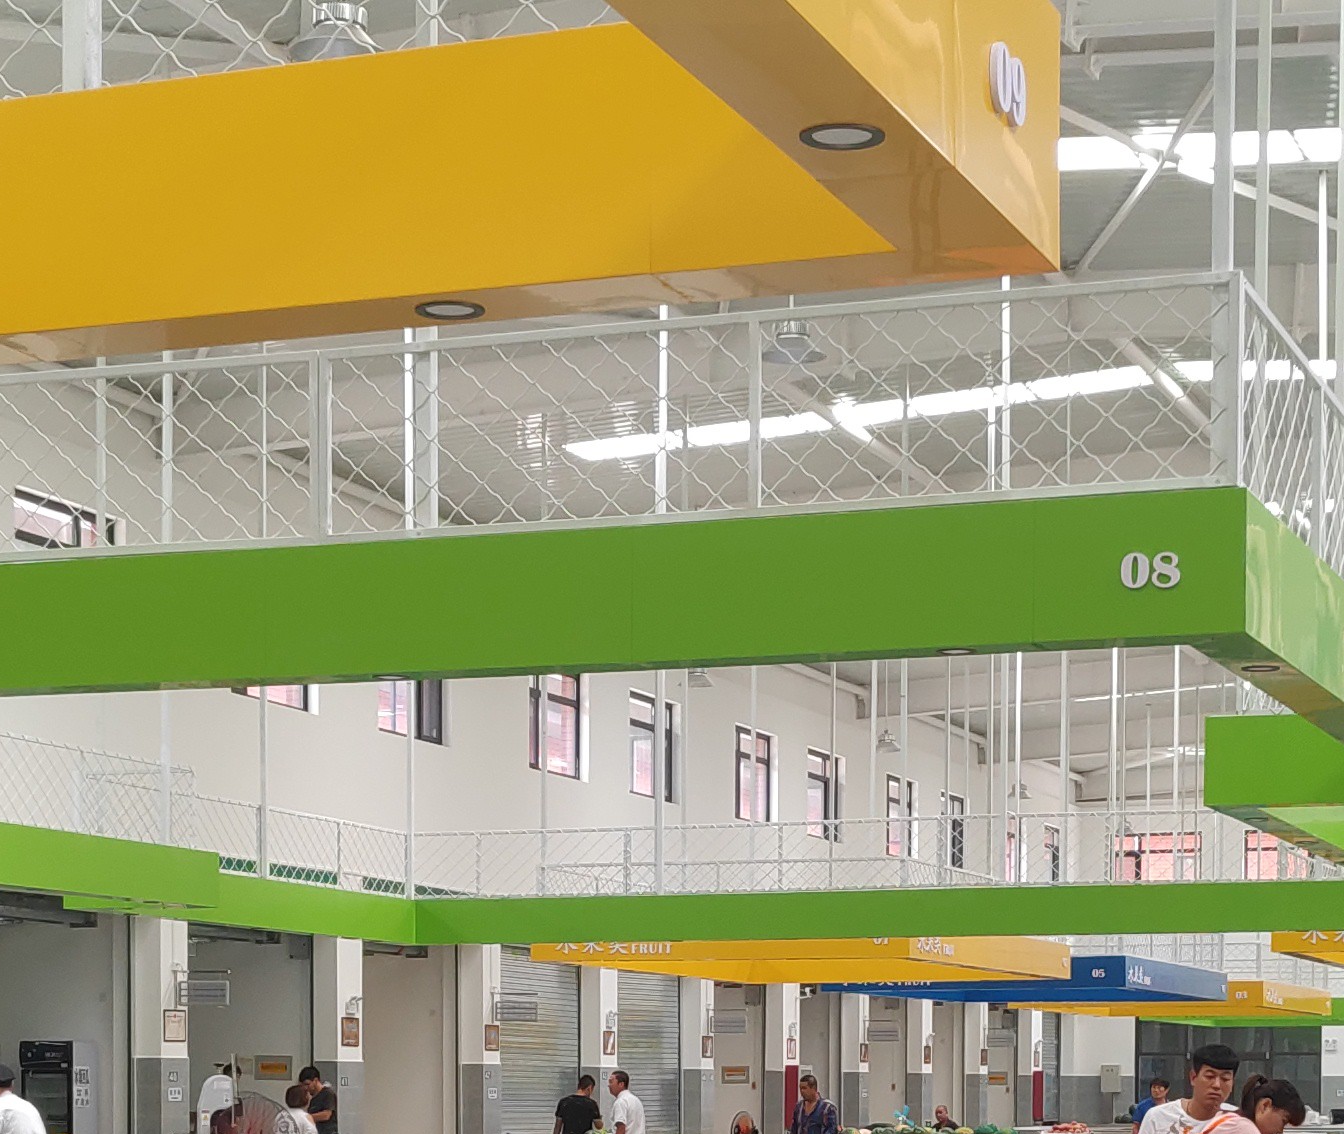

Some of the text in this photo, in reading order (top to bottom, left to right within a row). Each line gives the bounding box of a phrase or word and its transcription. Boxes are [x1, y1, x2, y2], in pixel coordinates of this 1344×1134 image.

[989, 41, 1026, 127] 09
[1120, 551, 1181, 589] 08
[631, 942, 672, 954] FRUIT
[1091, 968, 1106, 978] 05
